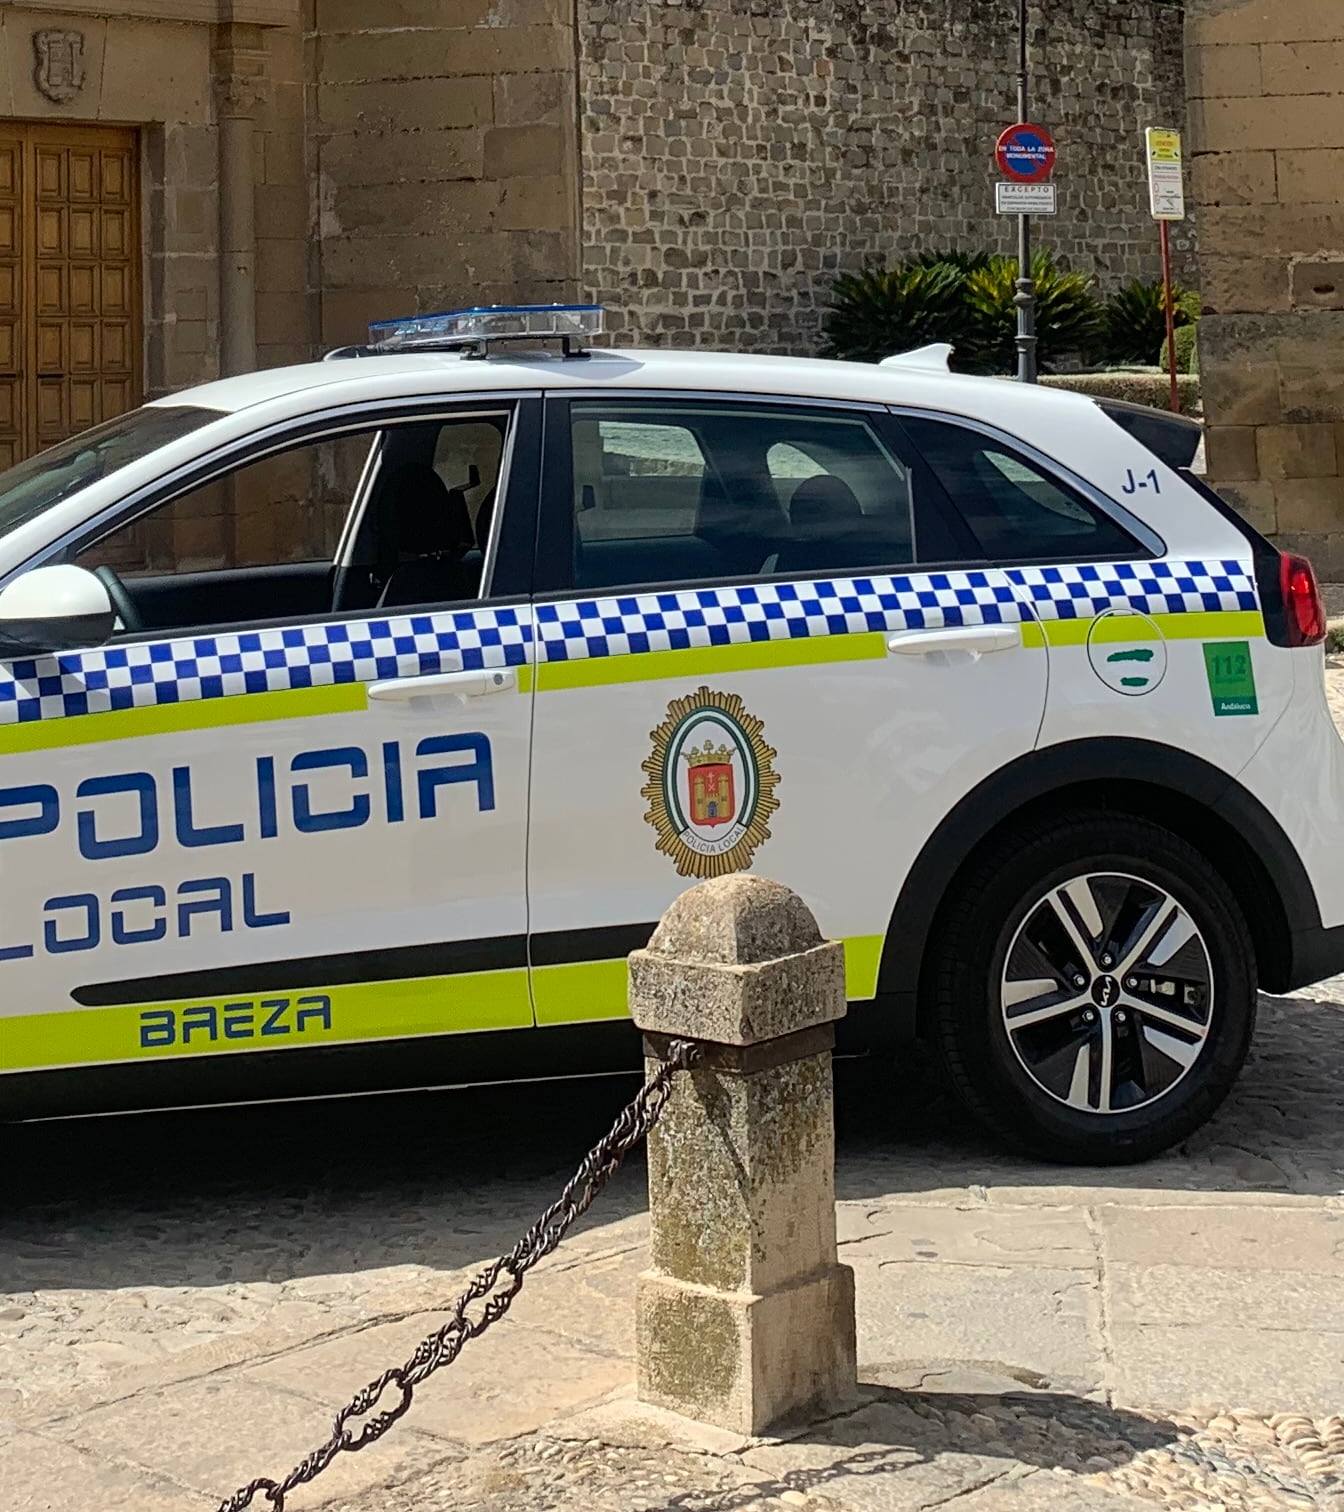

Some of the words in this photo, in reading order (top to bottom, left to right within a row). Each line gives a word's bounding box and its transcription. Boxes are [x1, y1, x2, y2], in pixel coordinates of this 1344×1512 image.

[1121, 468, 1161, 494] J-1
[1211, 654, 1247, 675] 112
[682, 830, 716, 854] POLICIA
[718, 827, 745, 852] LOCAL
[140, 994, 331, 1048] BAEZA
